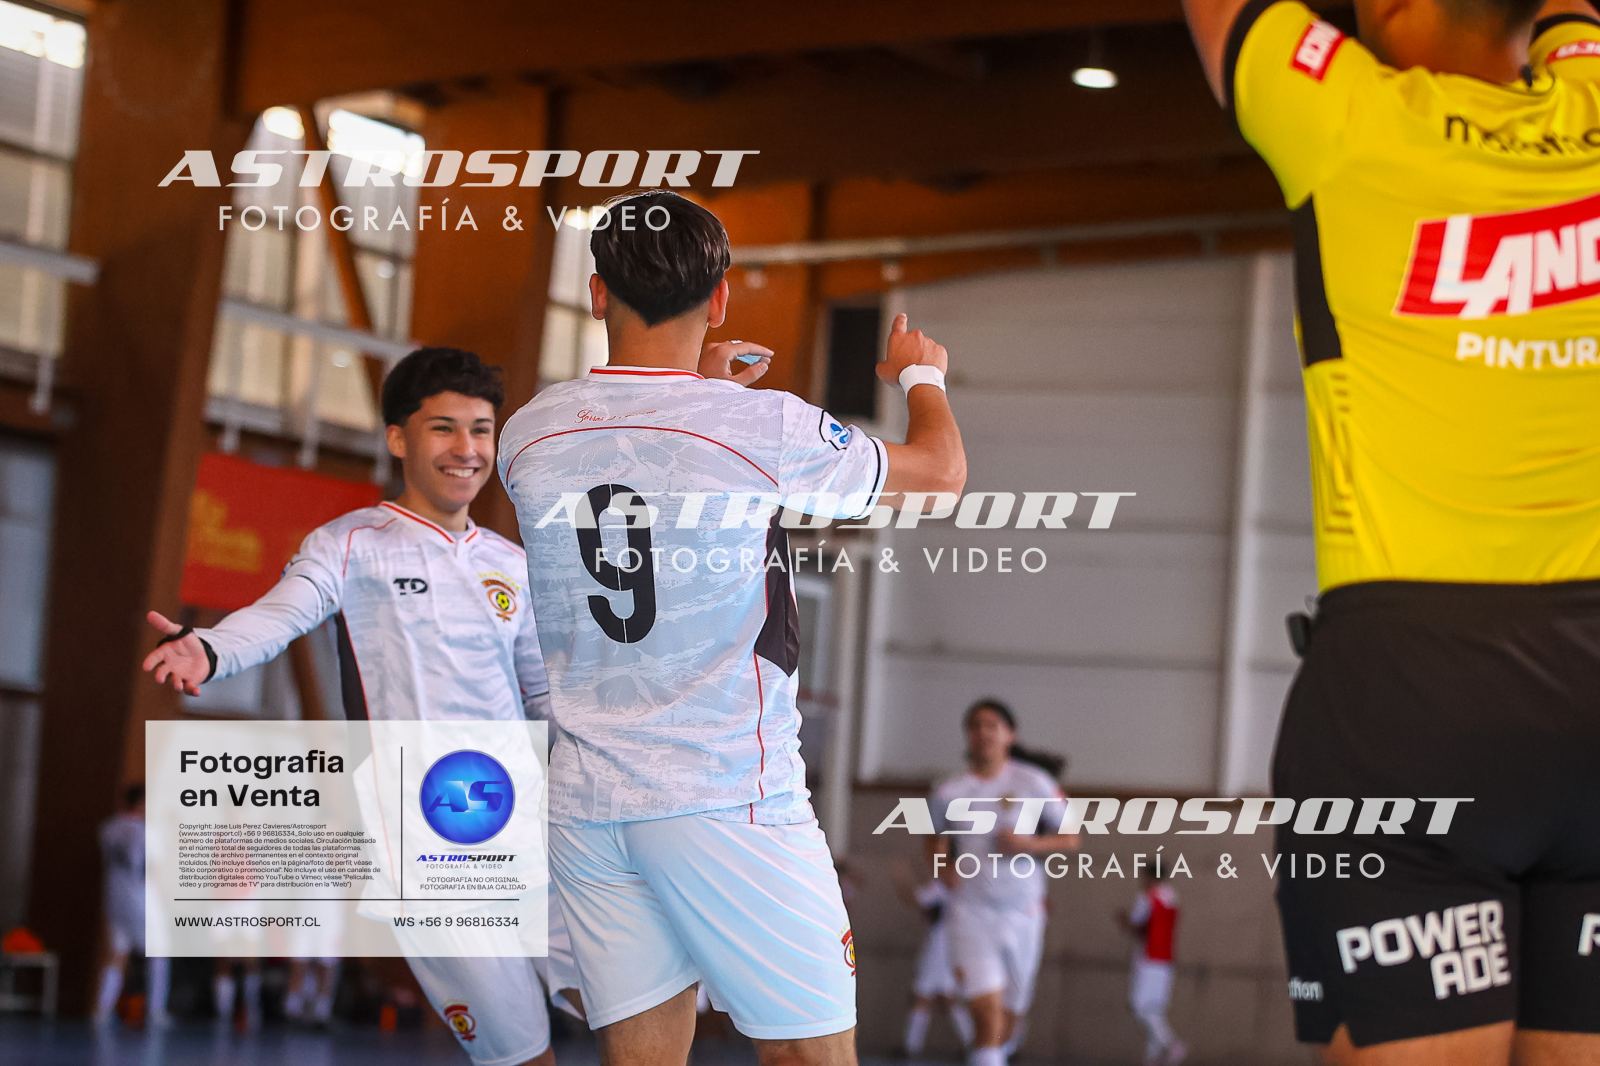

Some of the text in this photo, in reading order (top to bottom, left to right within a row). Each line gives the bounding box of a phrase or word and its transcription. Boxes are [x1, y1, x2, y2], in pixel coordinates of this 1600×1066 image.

[574, 484, 657, 643] 9
[1336, 900, 1505, 974] POWER
[1430, 943, 1512, 1000] ADE
